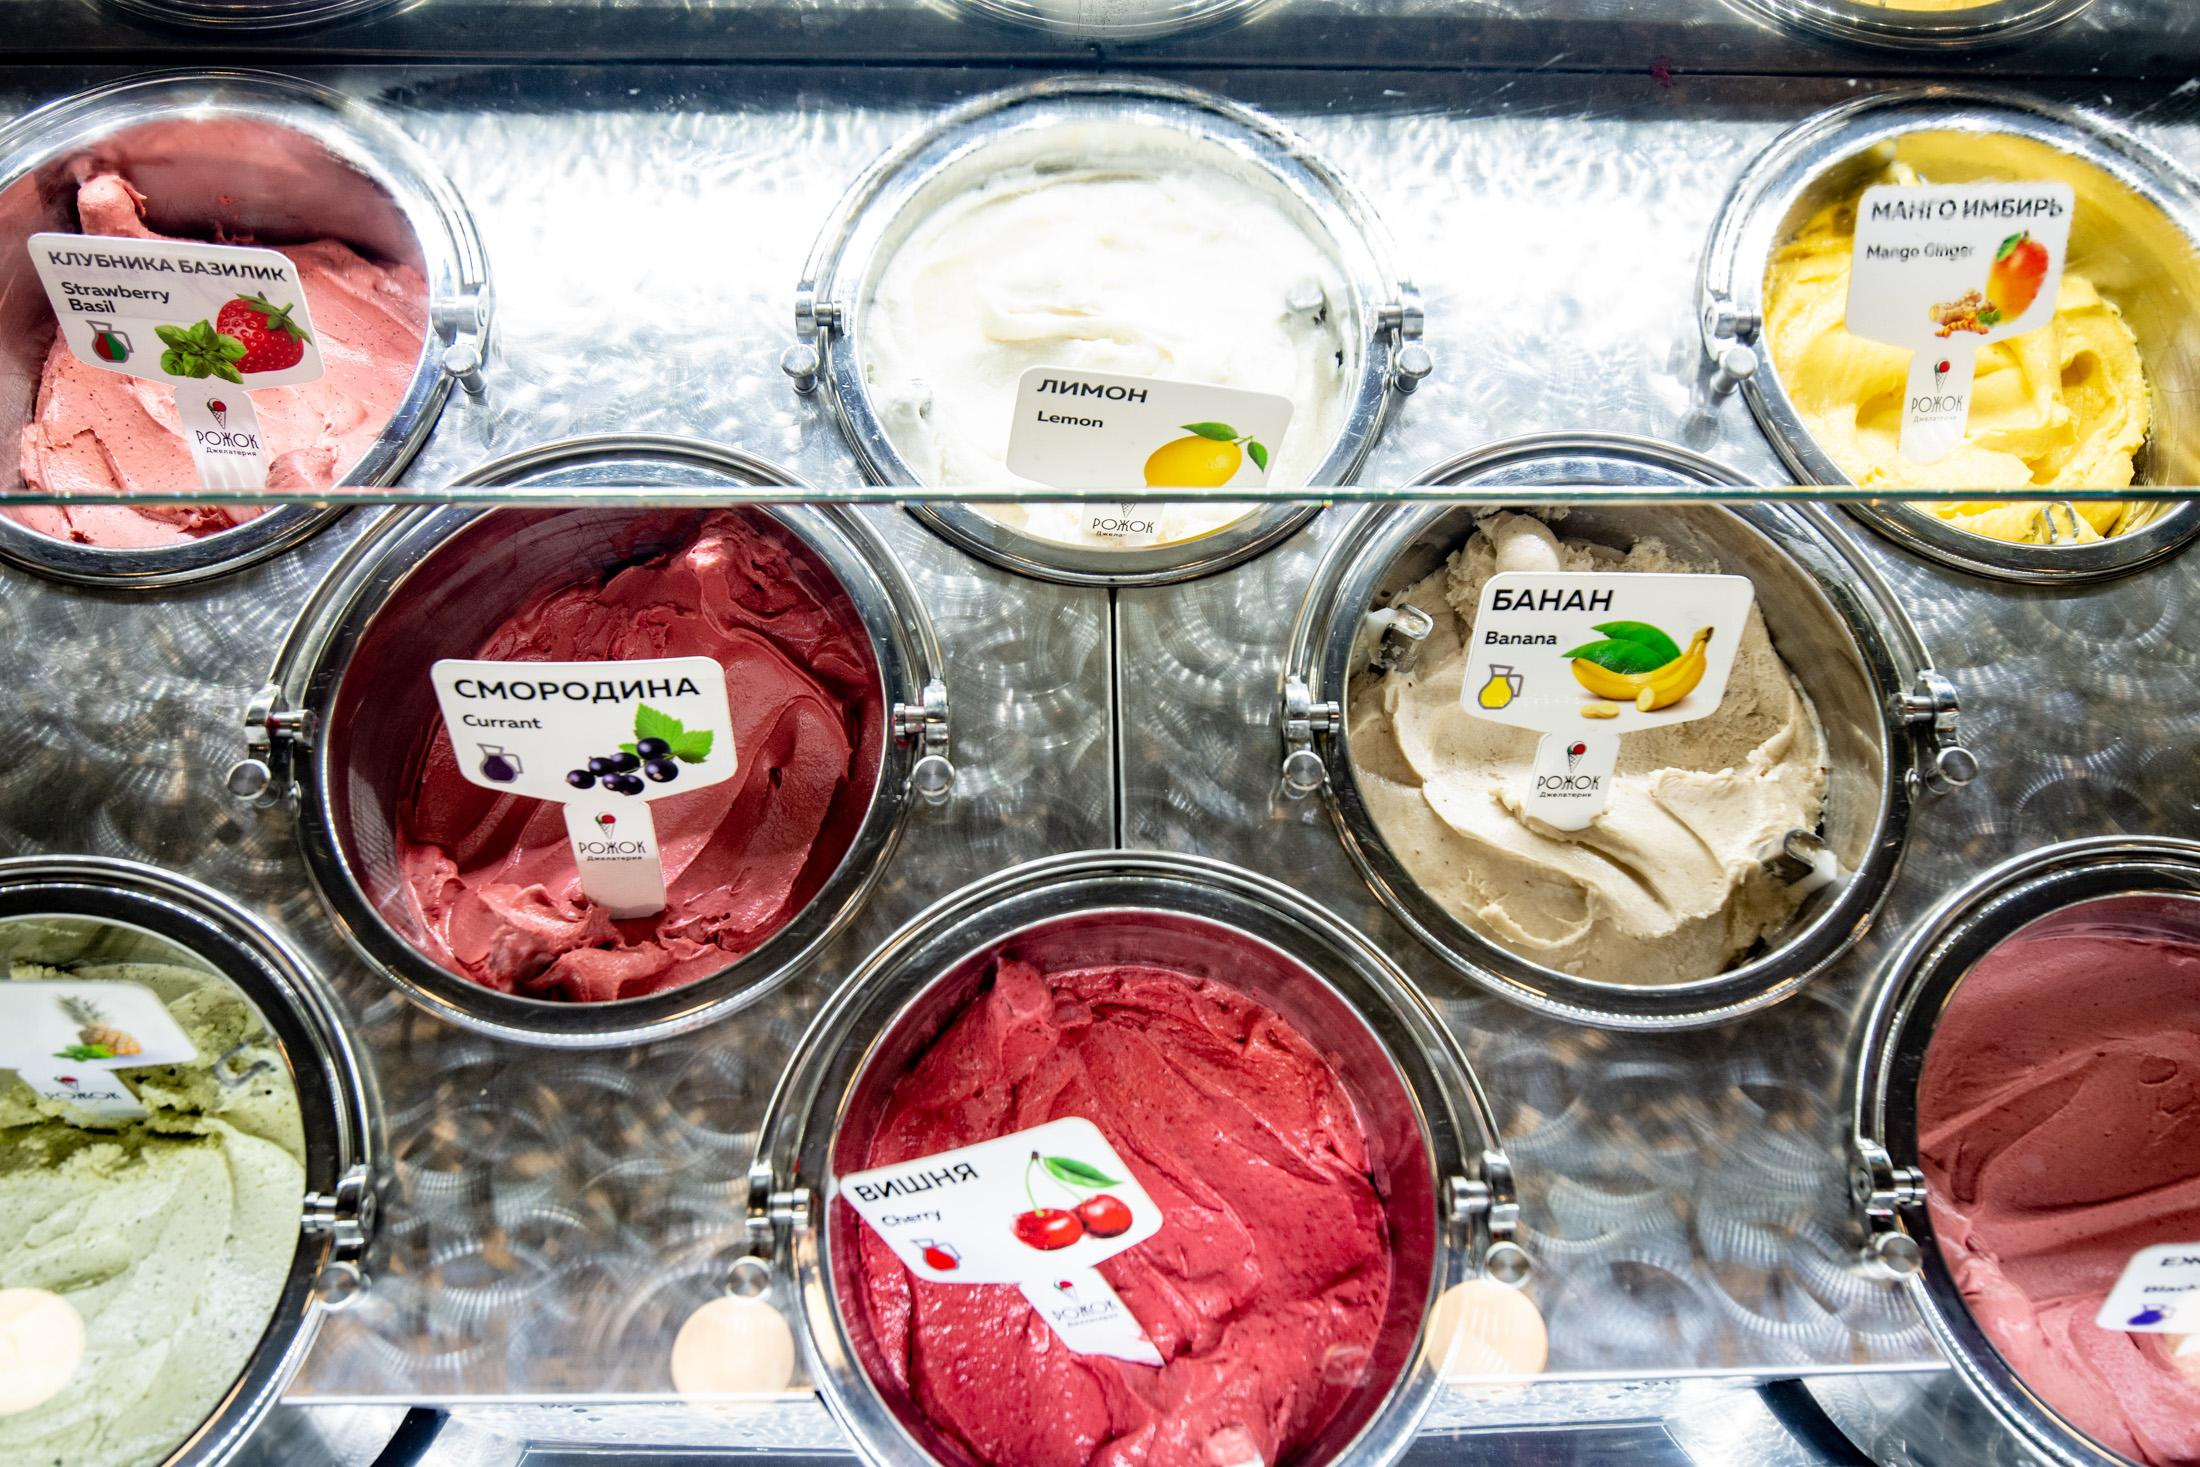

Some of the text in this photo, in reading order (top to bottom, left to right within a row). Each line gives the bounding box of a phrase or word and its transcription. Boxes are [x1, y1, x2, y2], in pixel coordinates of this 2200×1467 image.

[1871, 198, 2064, 221] МАНГО ИМБИРЬ
[1866, 243, 1975, 262] Mango Ginger
[47, 250, 288, 283] КЛУБНИКА БАЗИЛИК
[60, 281, 170, 304] Strawberry
[68, 298, 116, 314] Basil
[1036, 378, 1149, 403] ЛИМОН
[1910, 395, 1964, 414] РОЖОК
[1037, 410, 1104, 428] Lemon
[195, 429, 260, 450] РОЖОК
[206, 446, 257, 457] Джелатерия
[1092, 517, 1155, 534] РОЖОК
[1491, 588, 1615, 612] БАНАН
[1484, 630, 1558, 645] Banana
[453, 677, 701, 704] СМОРОДИНА
[462, 713, 543, 730] Currant
[1536, 775, 1602, 790] РОЖОК
[1539, 791, 1593, 799] Джелатерия
[578, 840, 647, 855] РОЖОК
[853, 1161, 980, 1202] ВИШНЯ
[881, 1210, 942, 1227] Cherry
